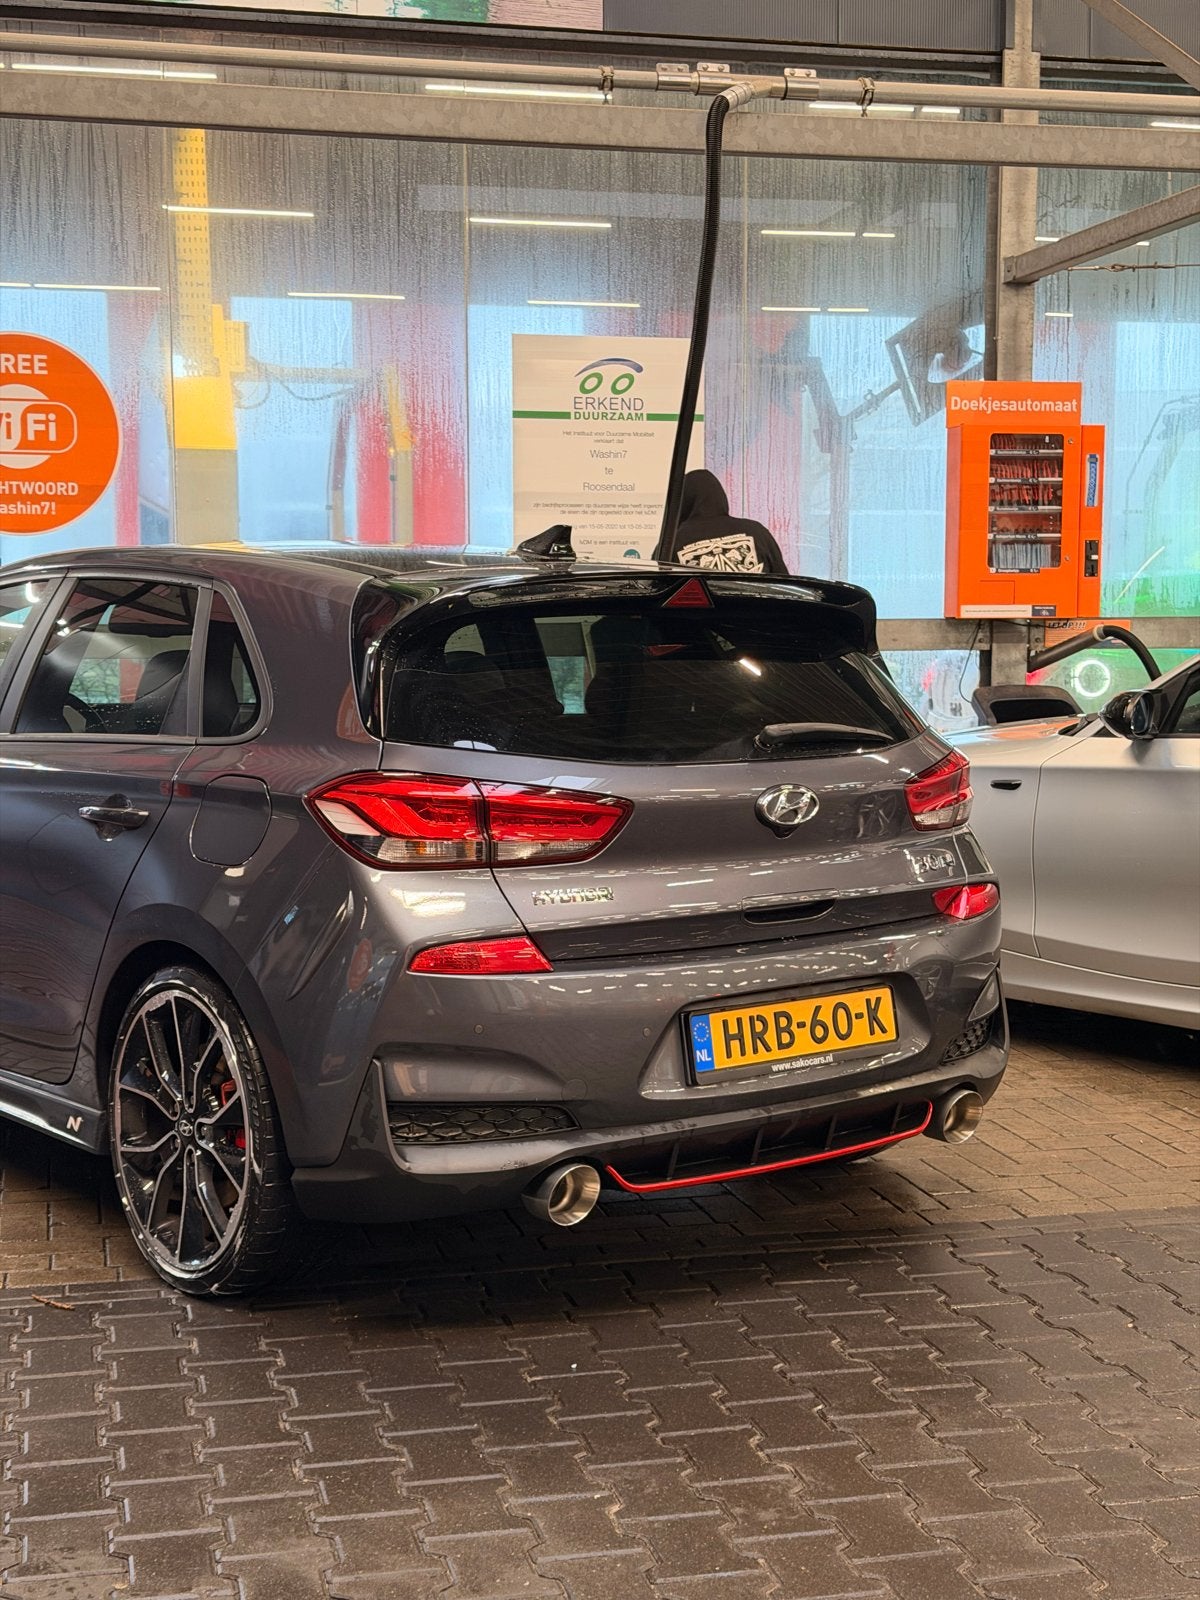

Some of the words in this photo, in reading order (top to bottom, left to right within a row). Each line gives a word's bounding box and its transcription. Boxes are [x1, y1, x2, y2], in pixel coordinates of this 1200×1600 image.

[573, 396, 644, 411] ERKEND
[950, 396, 1078, 417] Doekjesautomaat
[573, 412, 644, 422] DUURZAAM
[0, 412, 57, 442] iFi
[590, 450, 627, 459] Washin7
[605, 467, 614, 475] te
[583, 482, 635, 491] Roosendaal
[722, 996, 888, 1060] HRB-60-K
[696, 1049, 712, 1063] NL
[770, 1054, 834, 1072] www.sakocars.nl
[66, 1115, 83, 1132] N
